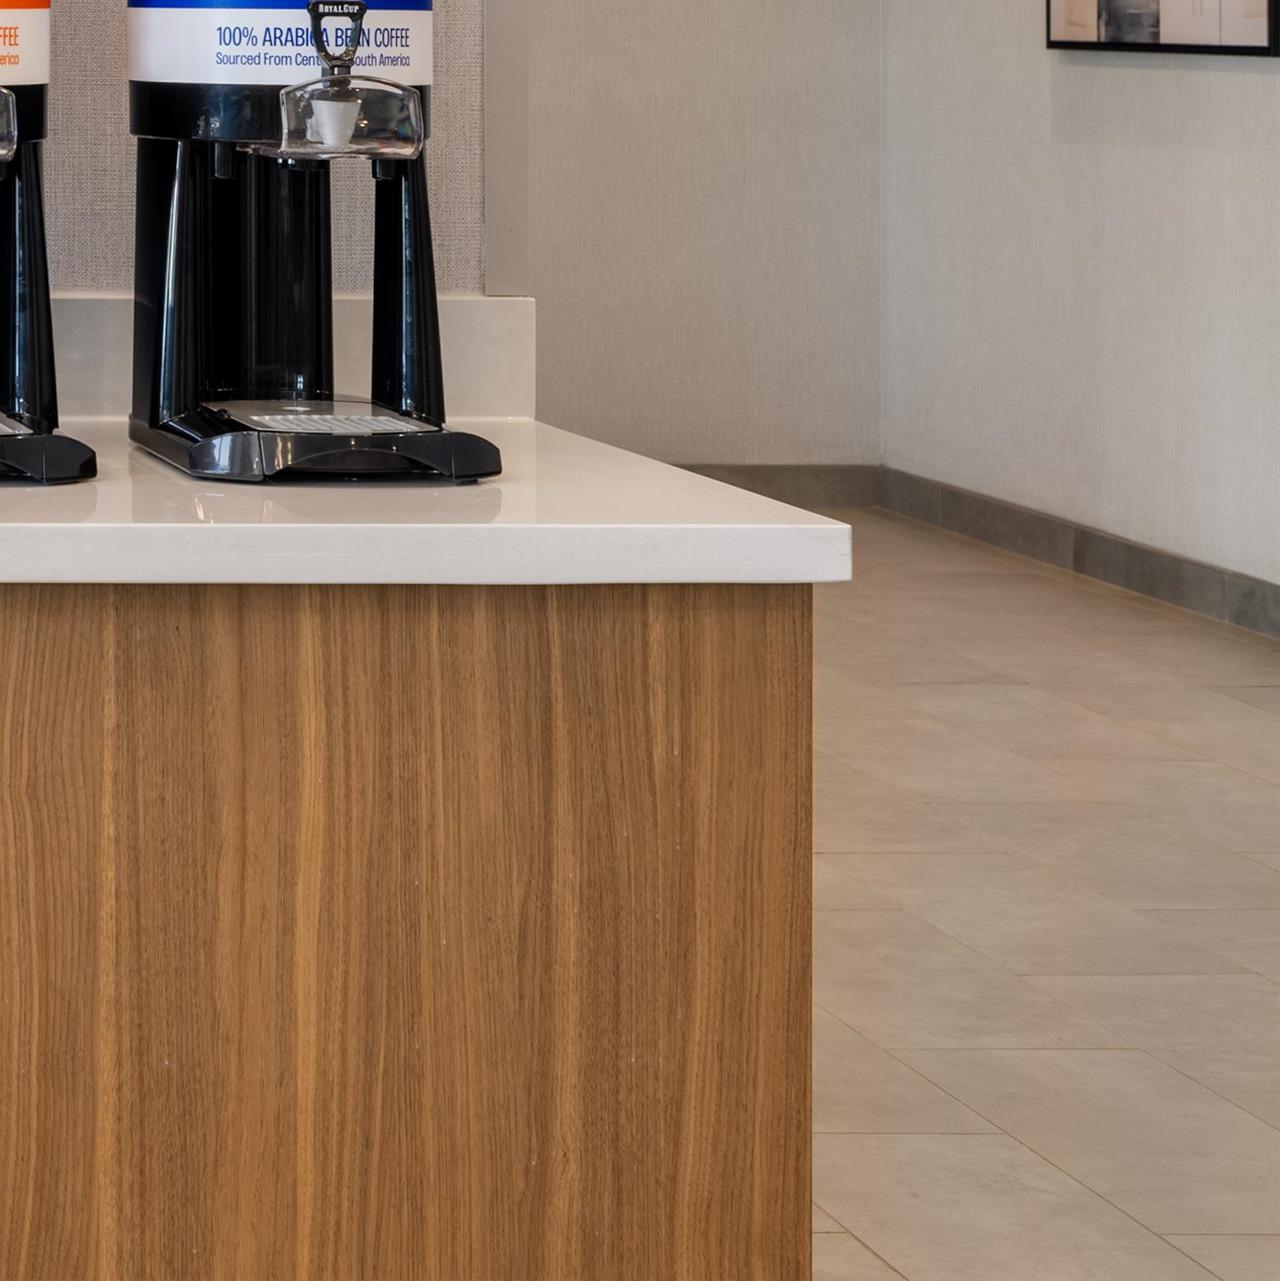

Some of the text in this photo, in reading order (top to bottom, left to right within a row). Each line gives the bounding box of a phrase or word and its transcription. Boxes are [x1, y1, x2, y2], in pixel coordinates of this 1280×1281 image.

[216, 26, 259, 48] 100%
[335, 27, 371, 48] BEN
[374, 27, 411, 48] COFFEE
[215, 51, 261, 67] Sourced
[263, 52, 293, 67] From
[378, 52, 410, 67] America
